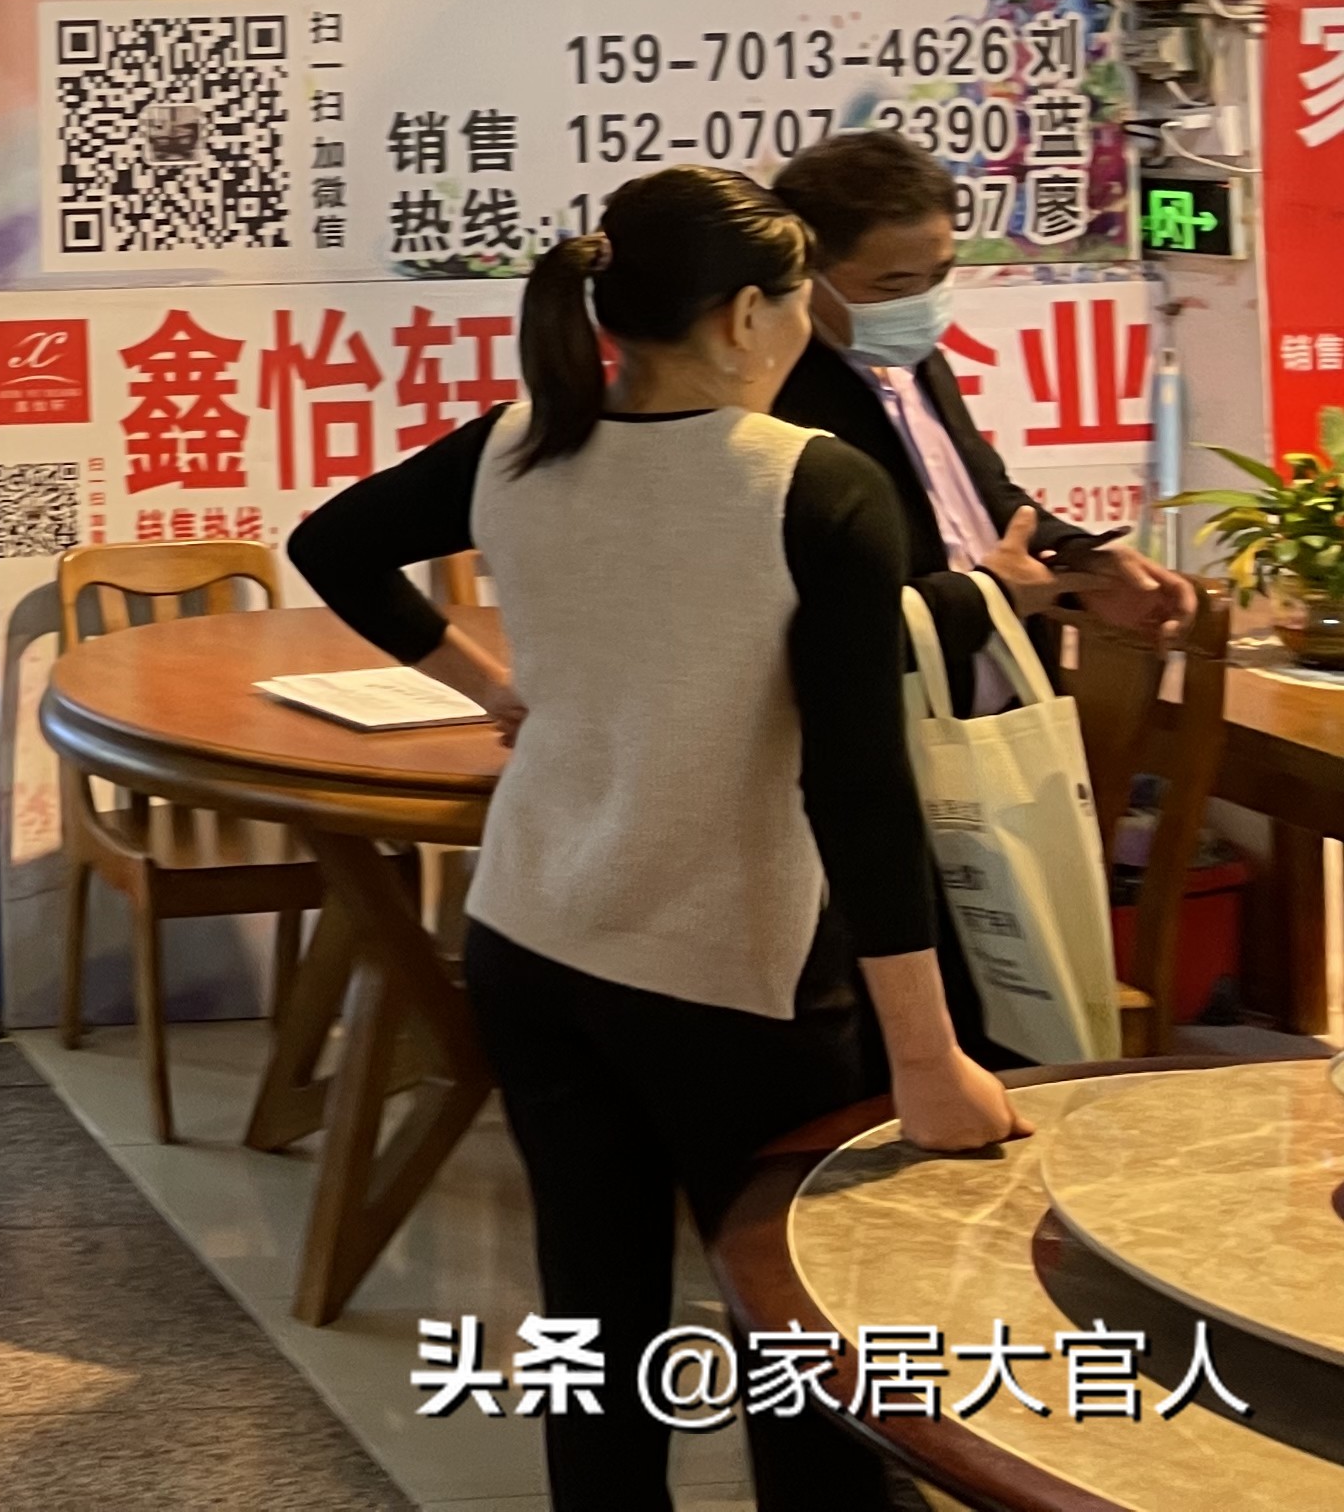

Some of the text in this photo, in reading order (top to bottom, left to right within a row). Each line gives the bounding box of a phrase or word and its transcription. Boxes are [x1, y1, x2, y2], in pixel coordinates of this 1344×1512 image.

[567, 26, 1009, 85] 159-7013-4626
[309, 11, 347, 249] 扫一扫加微信
[386, 108, 520, 175] 销售
[567, 104, 1009, 164] 152-0707390
[119, 304, 519, 495] 鑫怡轩
